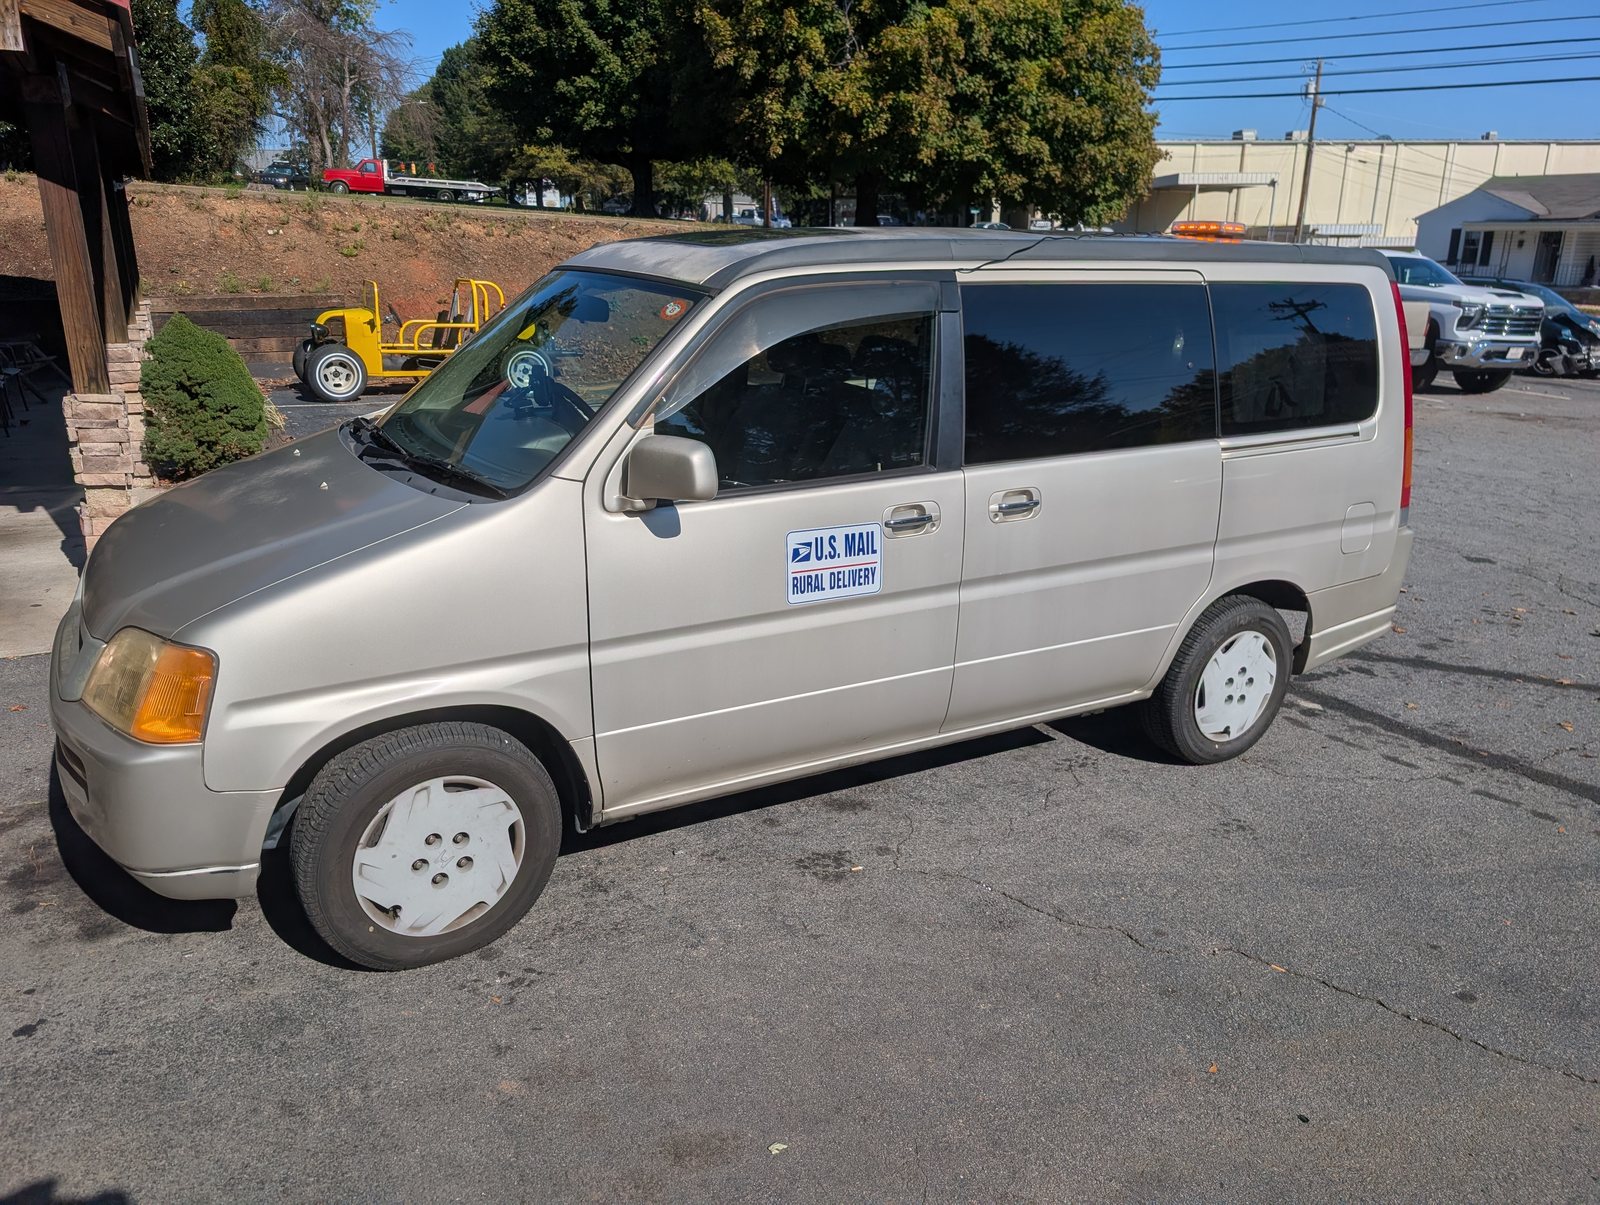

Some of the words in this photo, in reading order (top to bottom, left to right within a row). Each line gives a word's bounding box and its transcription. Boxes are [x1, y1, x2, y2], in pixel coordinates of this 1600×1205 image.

[815, 535, 840, 561] U.S.
[845, 531, 877, 557] MAIL
[792, 573, 825, 595] RURAL
[829, 566, 877, 590] DELIVERY
